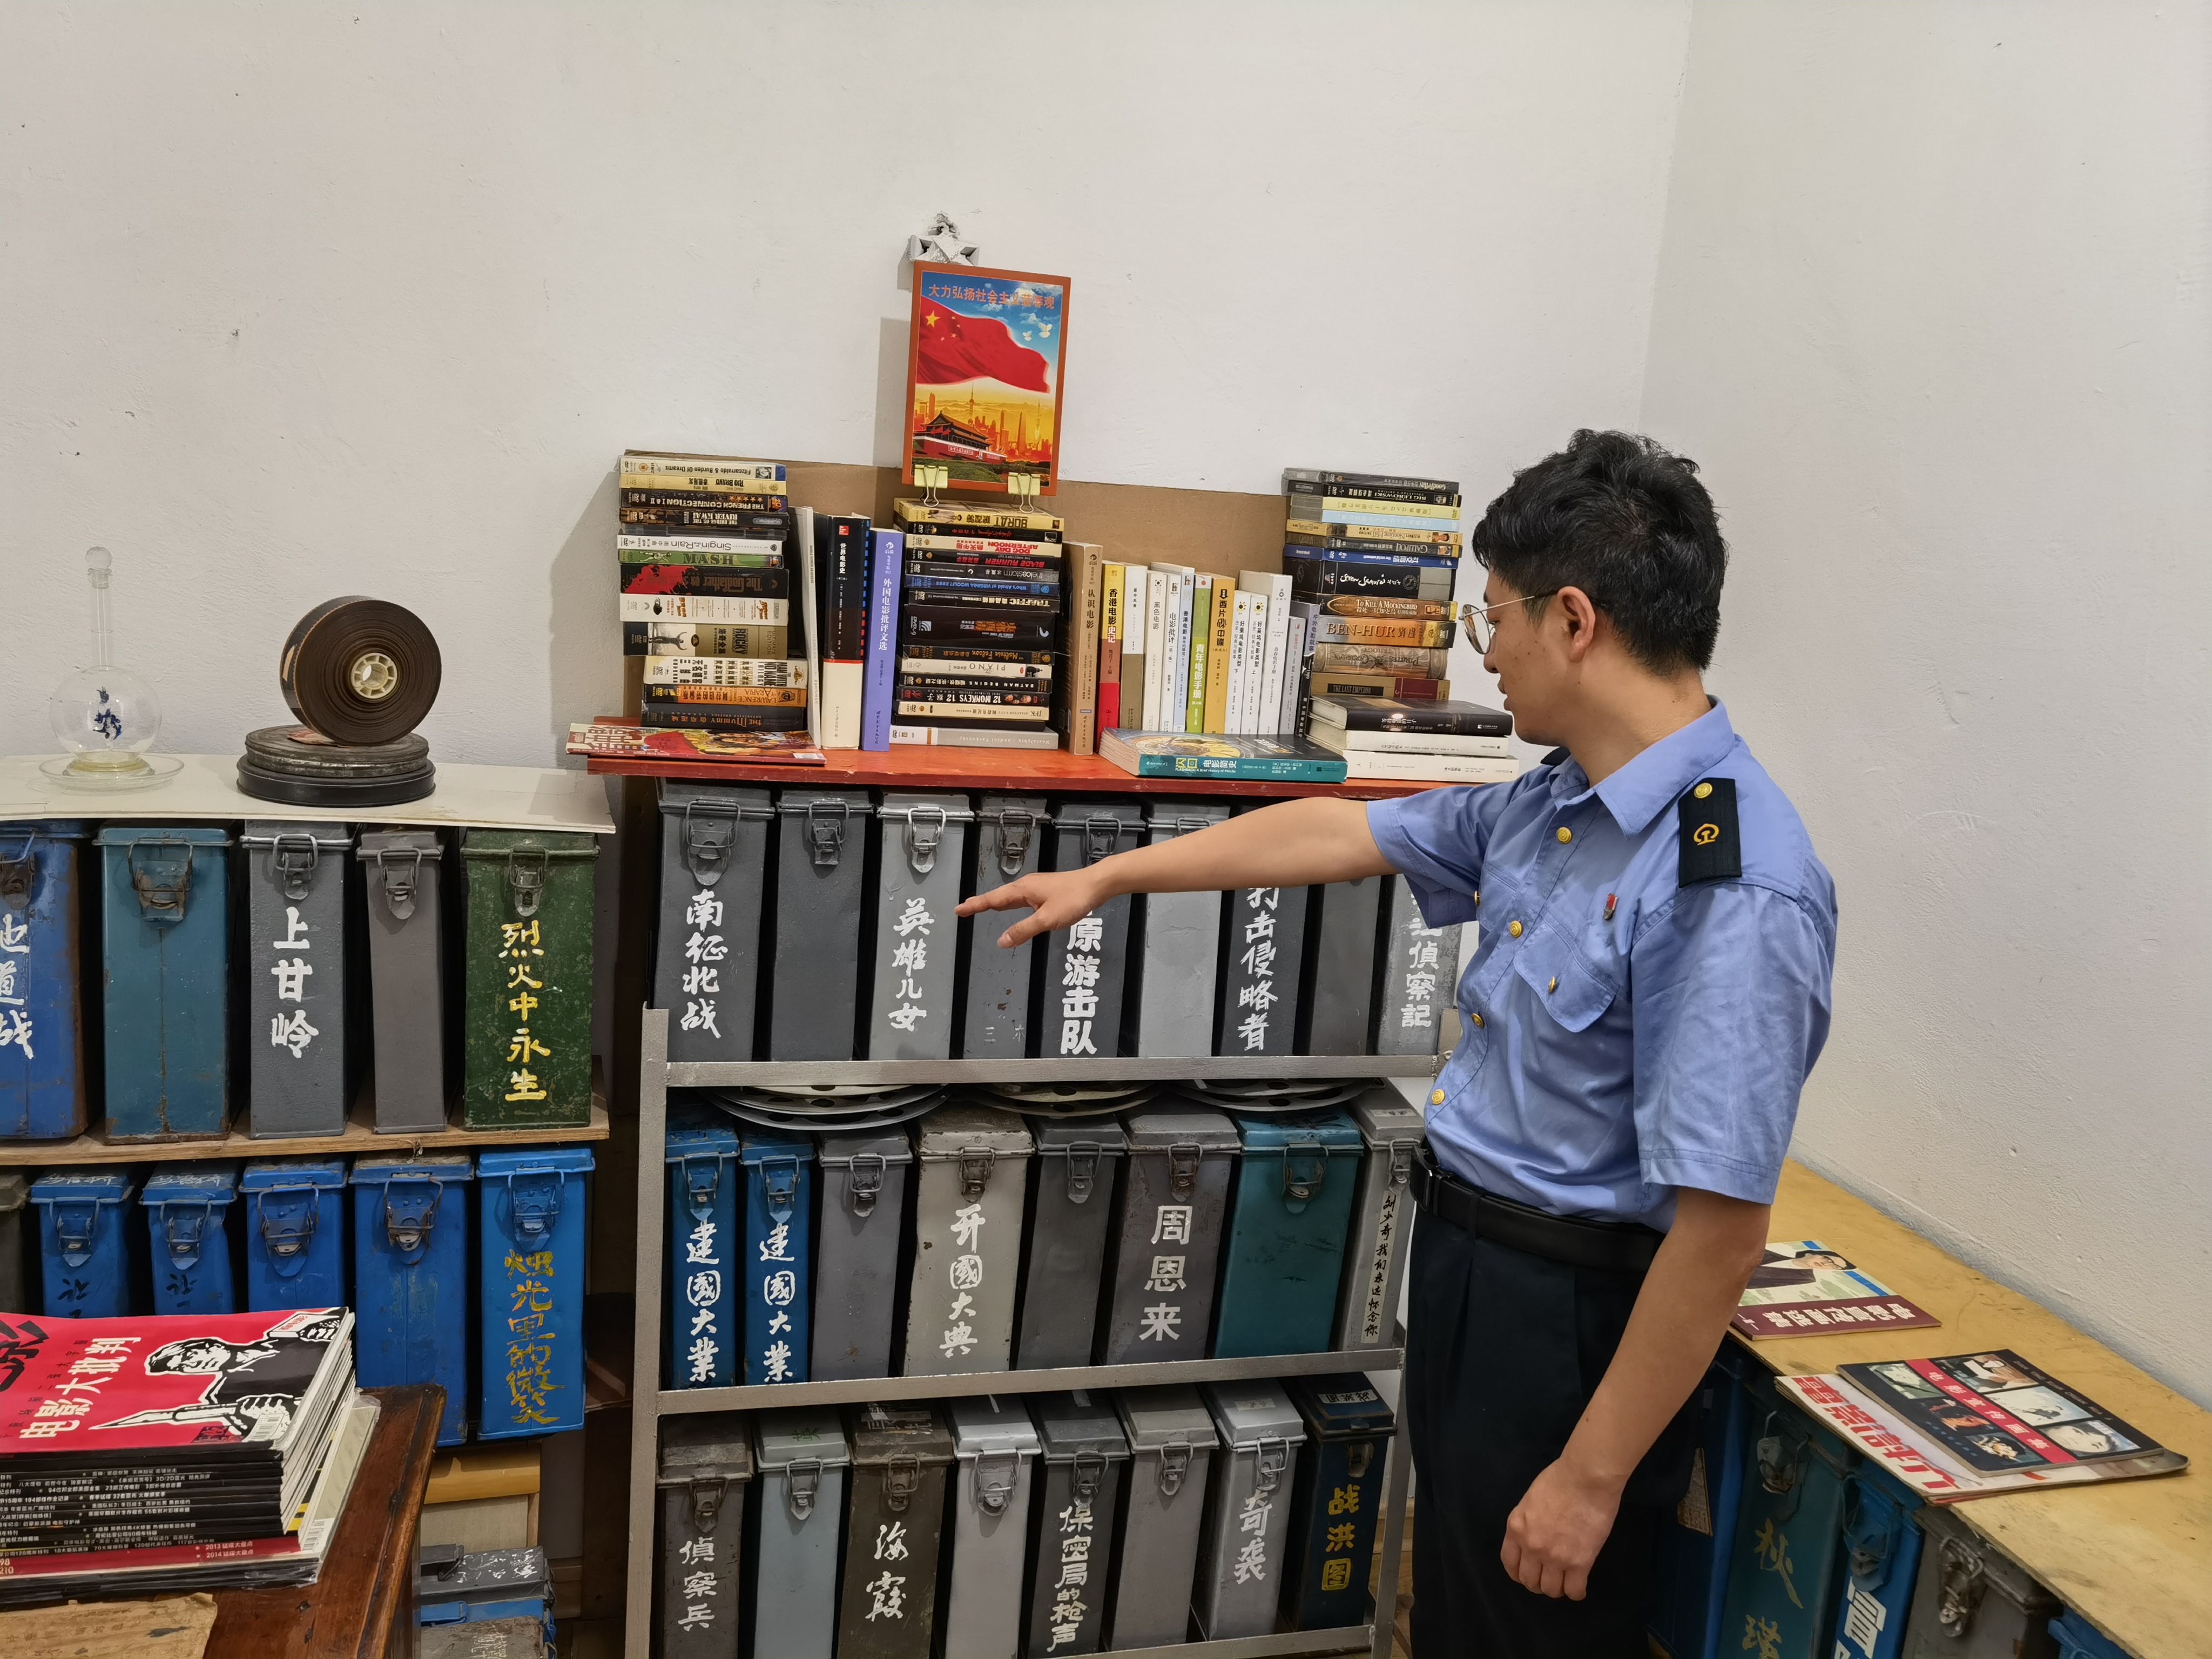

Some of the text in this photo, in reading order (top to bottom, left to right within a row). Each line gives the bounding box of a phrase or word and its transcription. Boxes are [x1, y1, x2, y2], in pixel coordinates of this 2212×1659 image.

[666, 499, 722, 508] CONNECTION
[1374, 492, 1413, 501] LEBOWSKI
[993, 516, 1028, 529] BORAT
[1384, 530, 1405, 539] Notting
[671, 541, 693, 549] Rain
[984, 558, 1019, 567] RUNNER
[988, 541, 1038, 550] AFTERNOON
[878, 578, 892, 651] 外国电影批评文选
[1009, 598, 1050, 607] TRAFFIC
[1086, 589, 1095, 629] 认识电影
[1108, 588, 1117, 643] 香港电影史记
[734, 628, 746, 655] ROCKY
[1168, 612, 1177, 644] 电影批评
[1325, 622, 1399, 638] BEN-HUR
[764, 662, 777, 686] NO NAME
[777, 662, 787, 687] MAN WITH
[969, 663, 1006, 671] PIANO
[1192, 644, 1204, 699] 青年电影手册
[946, 693, 956, 702] 12
[959, 694, 1002, 704] 12 MONKEYS
[1202, 759, 1237, 769] 电影简史
[680, 889, 728, 1038] 南征北战
[888, 897, 935, 1032] 英雄儿女
[1401, 894, 1442, 1027] 江偵察記
[270, 907, 319, 1058] 上甘岭
[1060, 910, 1102, 1055] 原游击队
[501, 920, 551, 1101] 烈火中永生
[1139, 1205, 1193, 1342] 周恩来
[504, 1248, 565, 1424] 烛光里的微笑
[19, 1337, 142, 1439] 电影大批判
[1321, 1484, 1360, 1591] 战洪图
[678, 1537, 717, 1632] 偵察兵
[865, 1521, 909, 1621] 海霞
[1047, 1505, 1094, 1653] 保密局的枪声
